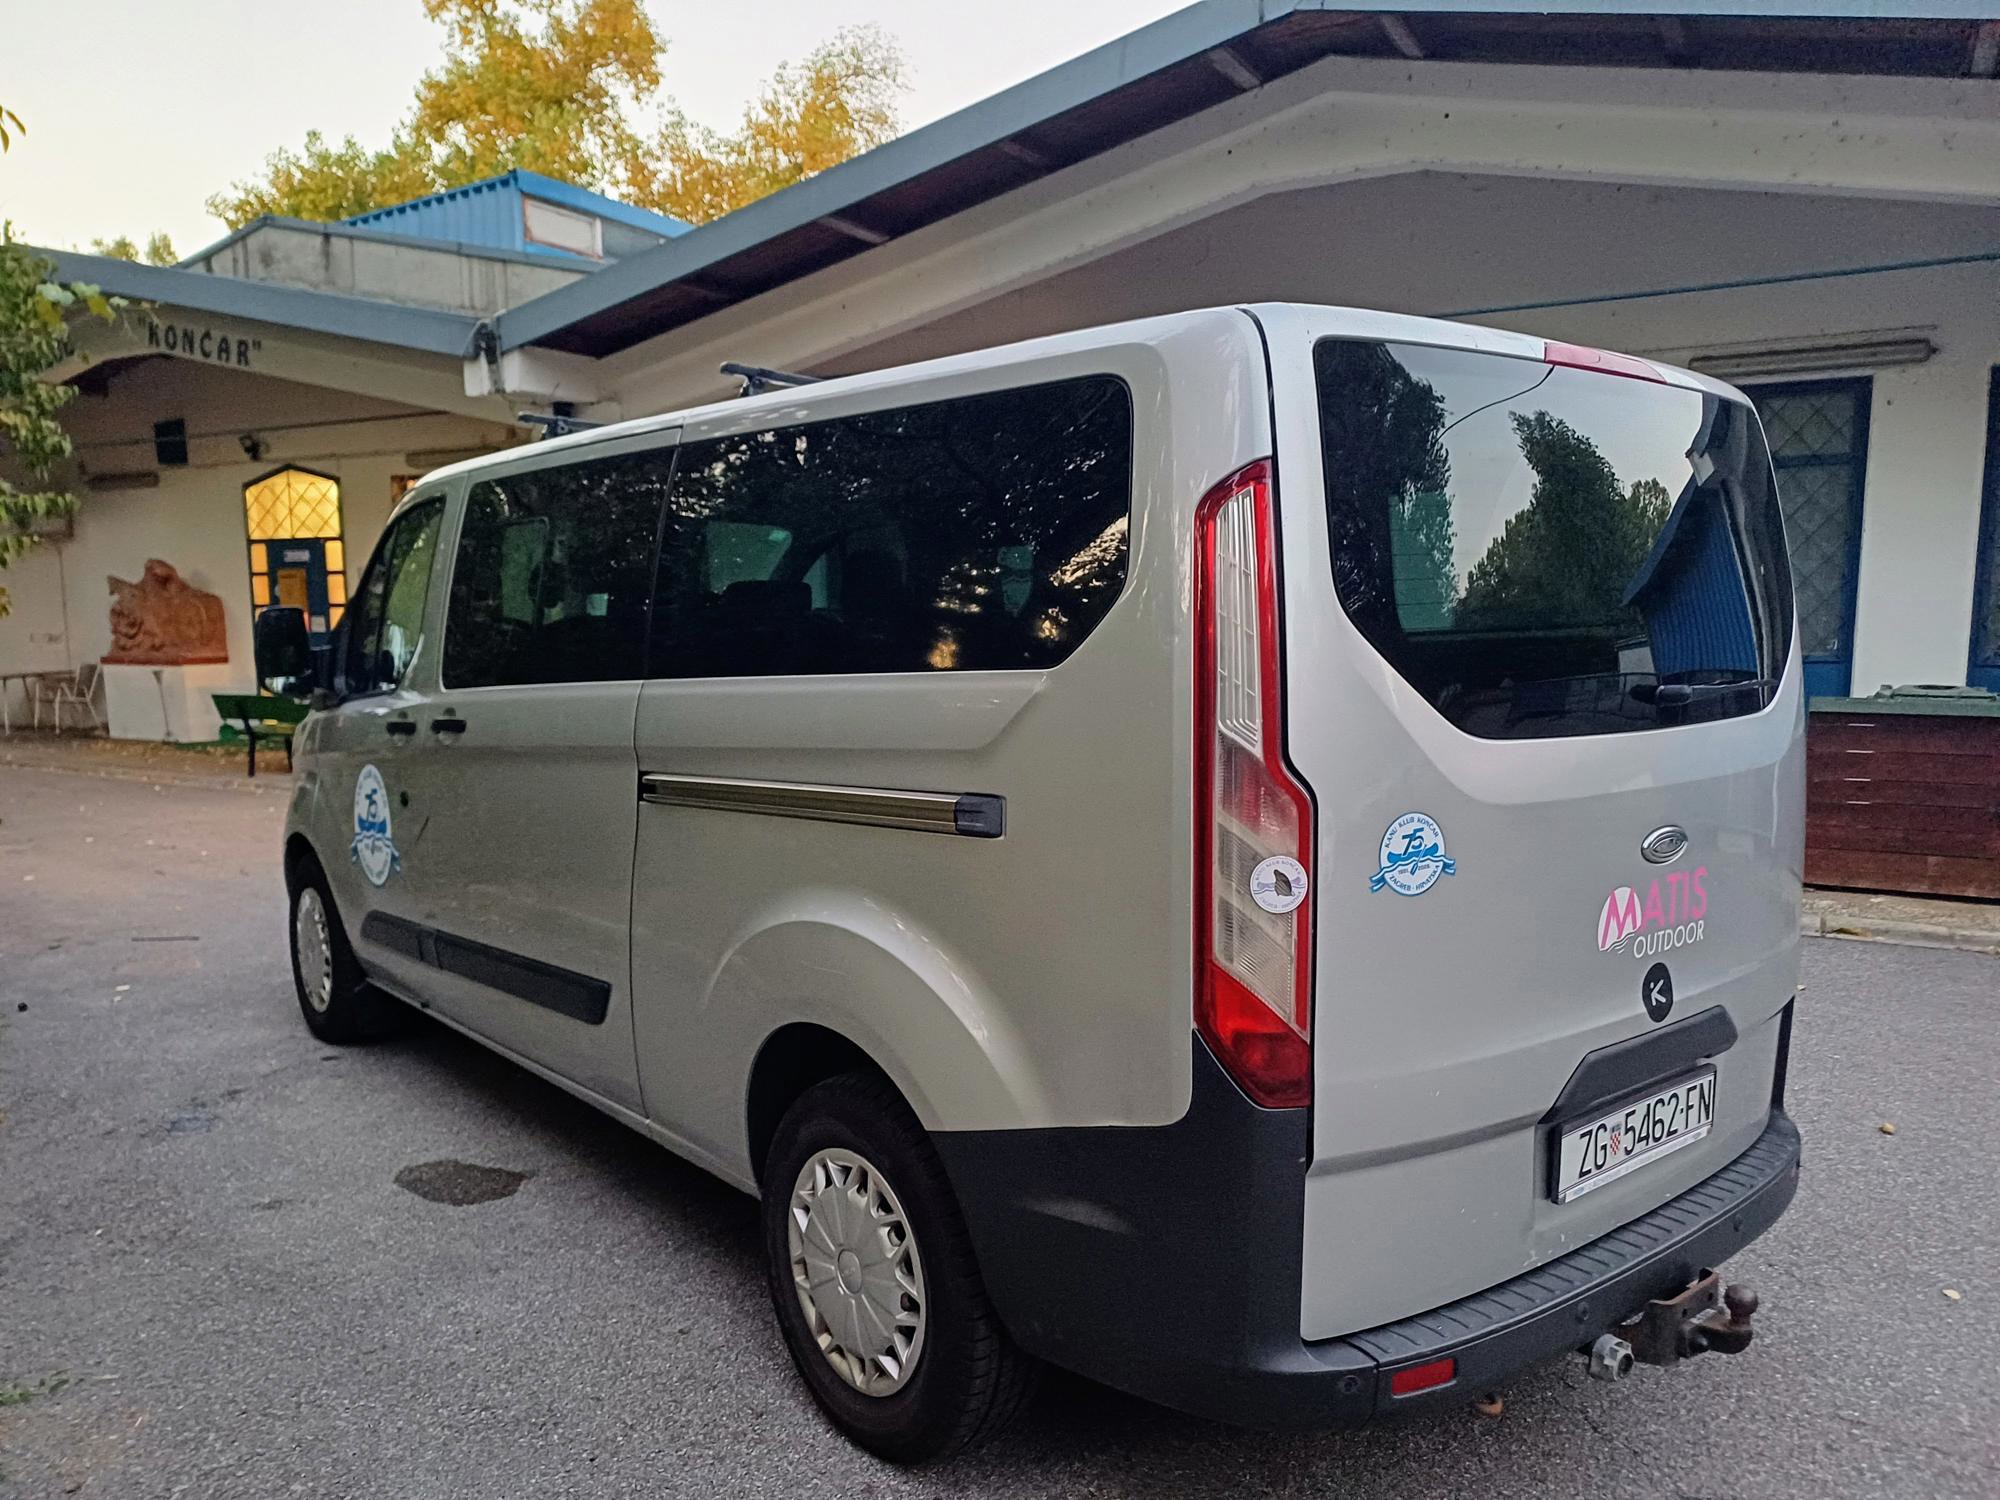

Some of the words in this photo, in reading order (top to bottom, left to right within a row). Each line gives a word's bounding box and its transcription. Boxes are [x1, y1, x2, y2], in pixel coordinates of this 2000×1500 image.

[1600, 866, 1708, 948] MATIS
[1633, 920, 1704, 958] OUTDOOR
[1578, 1123, 1608, 1179] ZG
